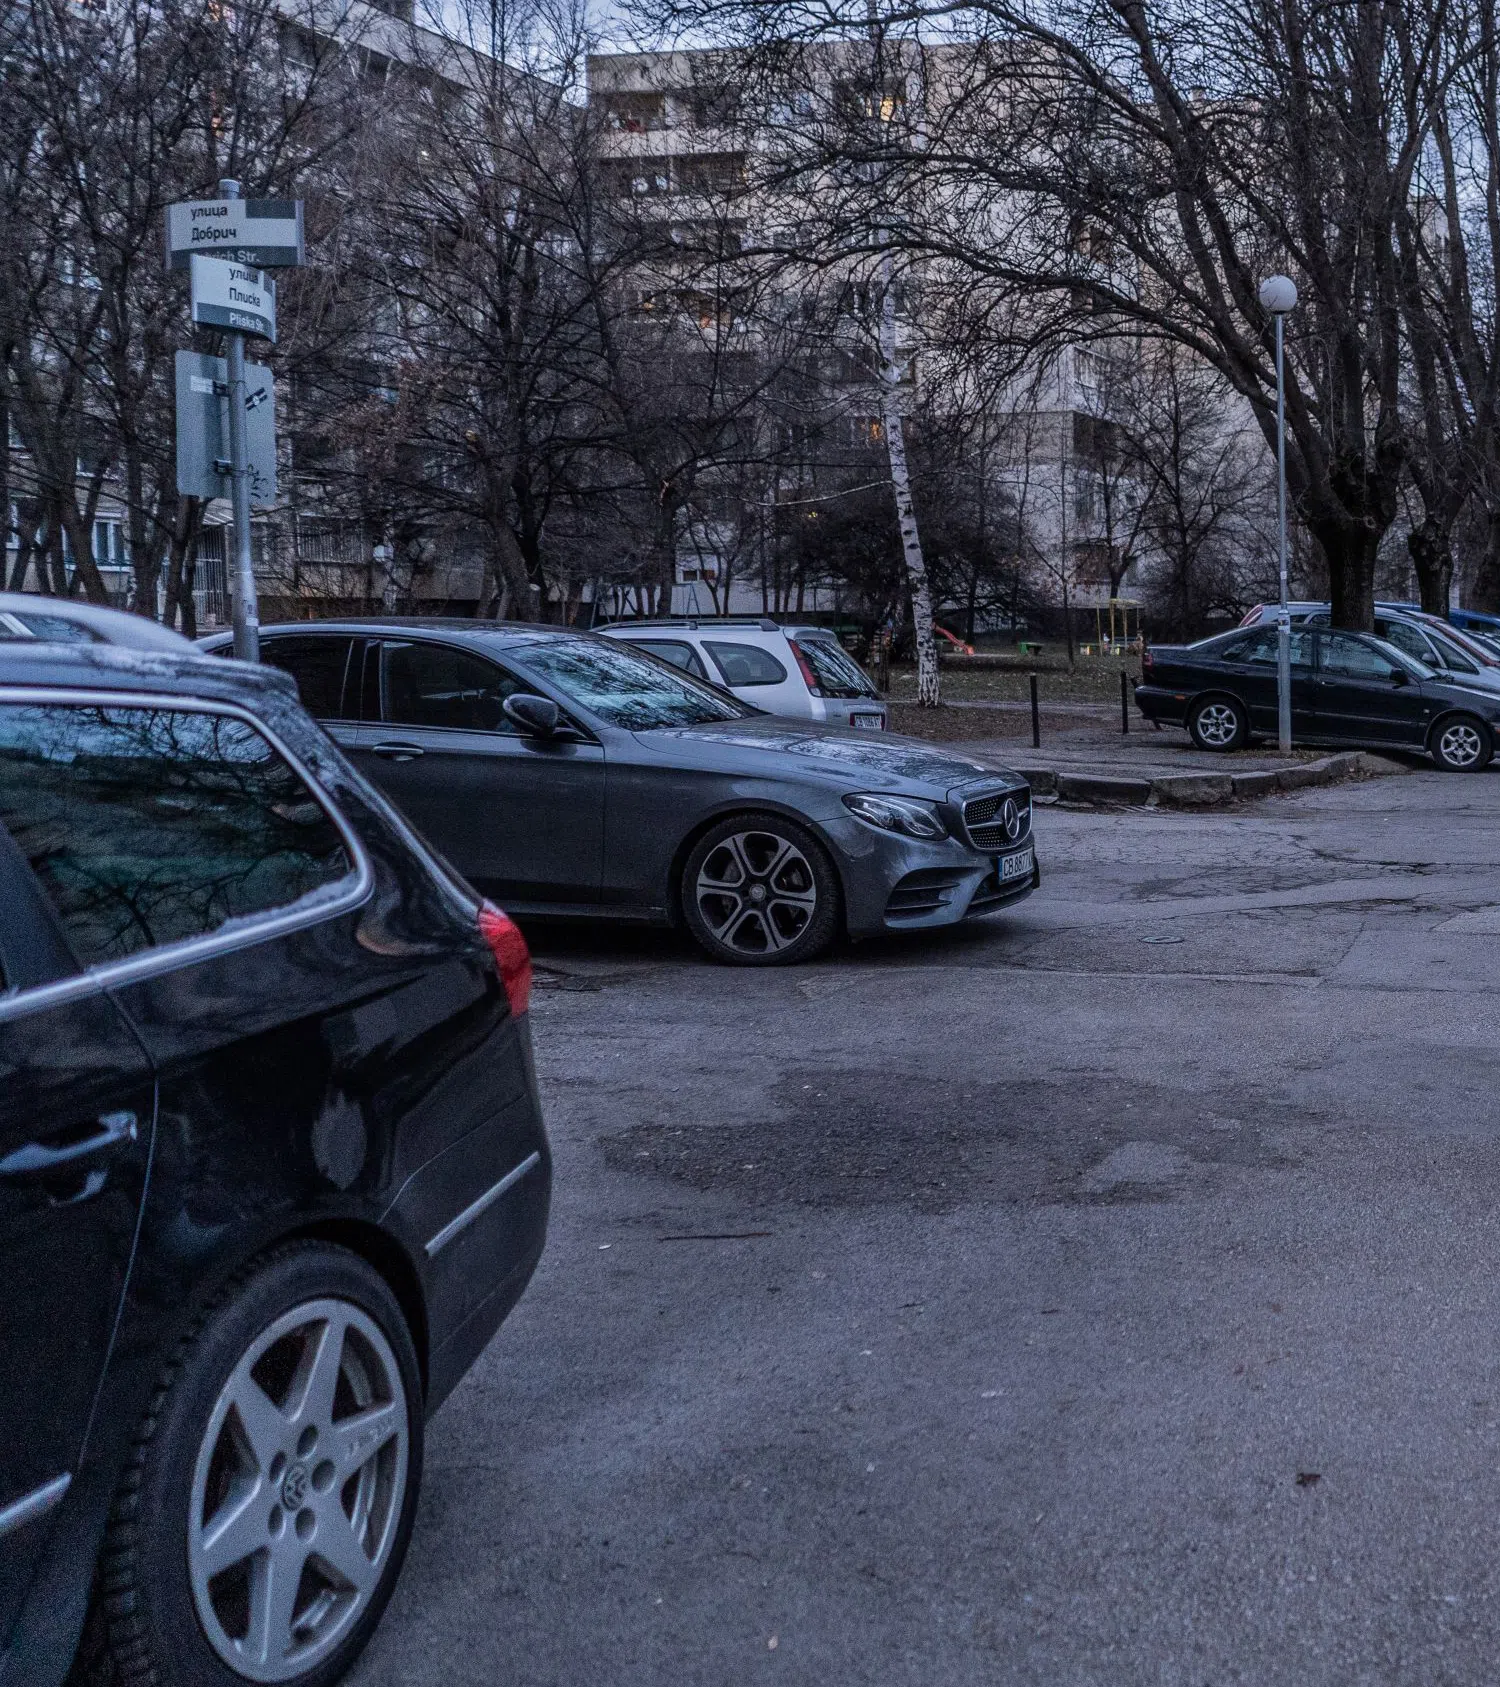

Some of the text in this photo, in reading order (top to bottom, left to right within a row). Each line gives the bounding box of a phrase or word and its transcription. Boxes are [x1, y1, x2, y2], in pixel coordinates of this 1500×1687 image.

[190, 205, 228, 220] улица
[191, 227, 237, 242] Добрич
[237, 250, 260, 262] Str.
[228, 268, 259, 285] улица
[229, 287, 261, 307] Плиска
[229, 312, 255, 330] Pliska
